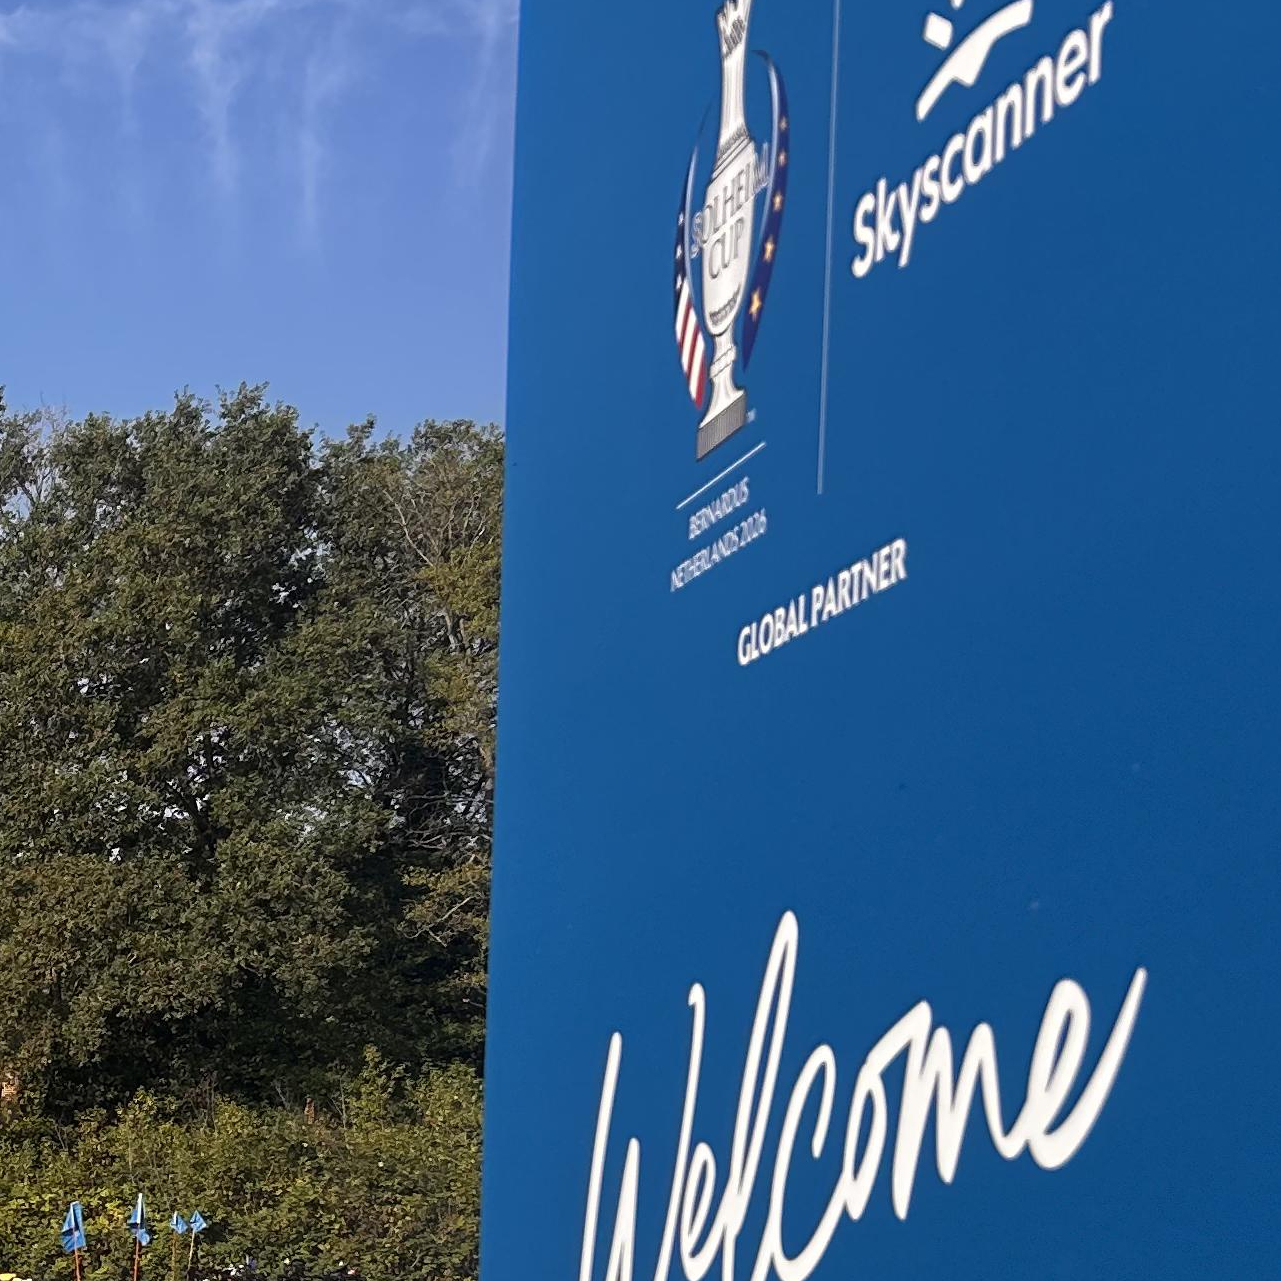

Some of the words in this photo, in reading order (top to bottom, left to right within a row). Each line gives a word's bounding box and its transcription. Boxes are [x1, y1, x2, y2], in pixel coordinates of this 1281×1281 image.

[852, 1, 1113, 277] Skyscanner
[691, 141, 770, 258] SOLHEIM
[707, 216, 745, 280] CUP
[671, 526, 739, 592] NETHERLANDS
[739, 507, 767, 548] 2026
[689, 476, 749, 540] BERNARDUS
[738, 594, 808, 666] GLOBAL
[811, 538, 907, 627] PARTNER
